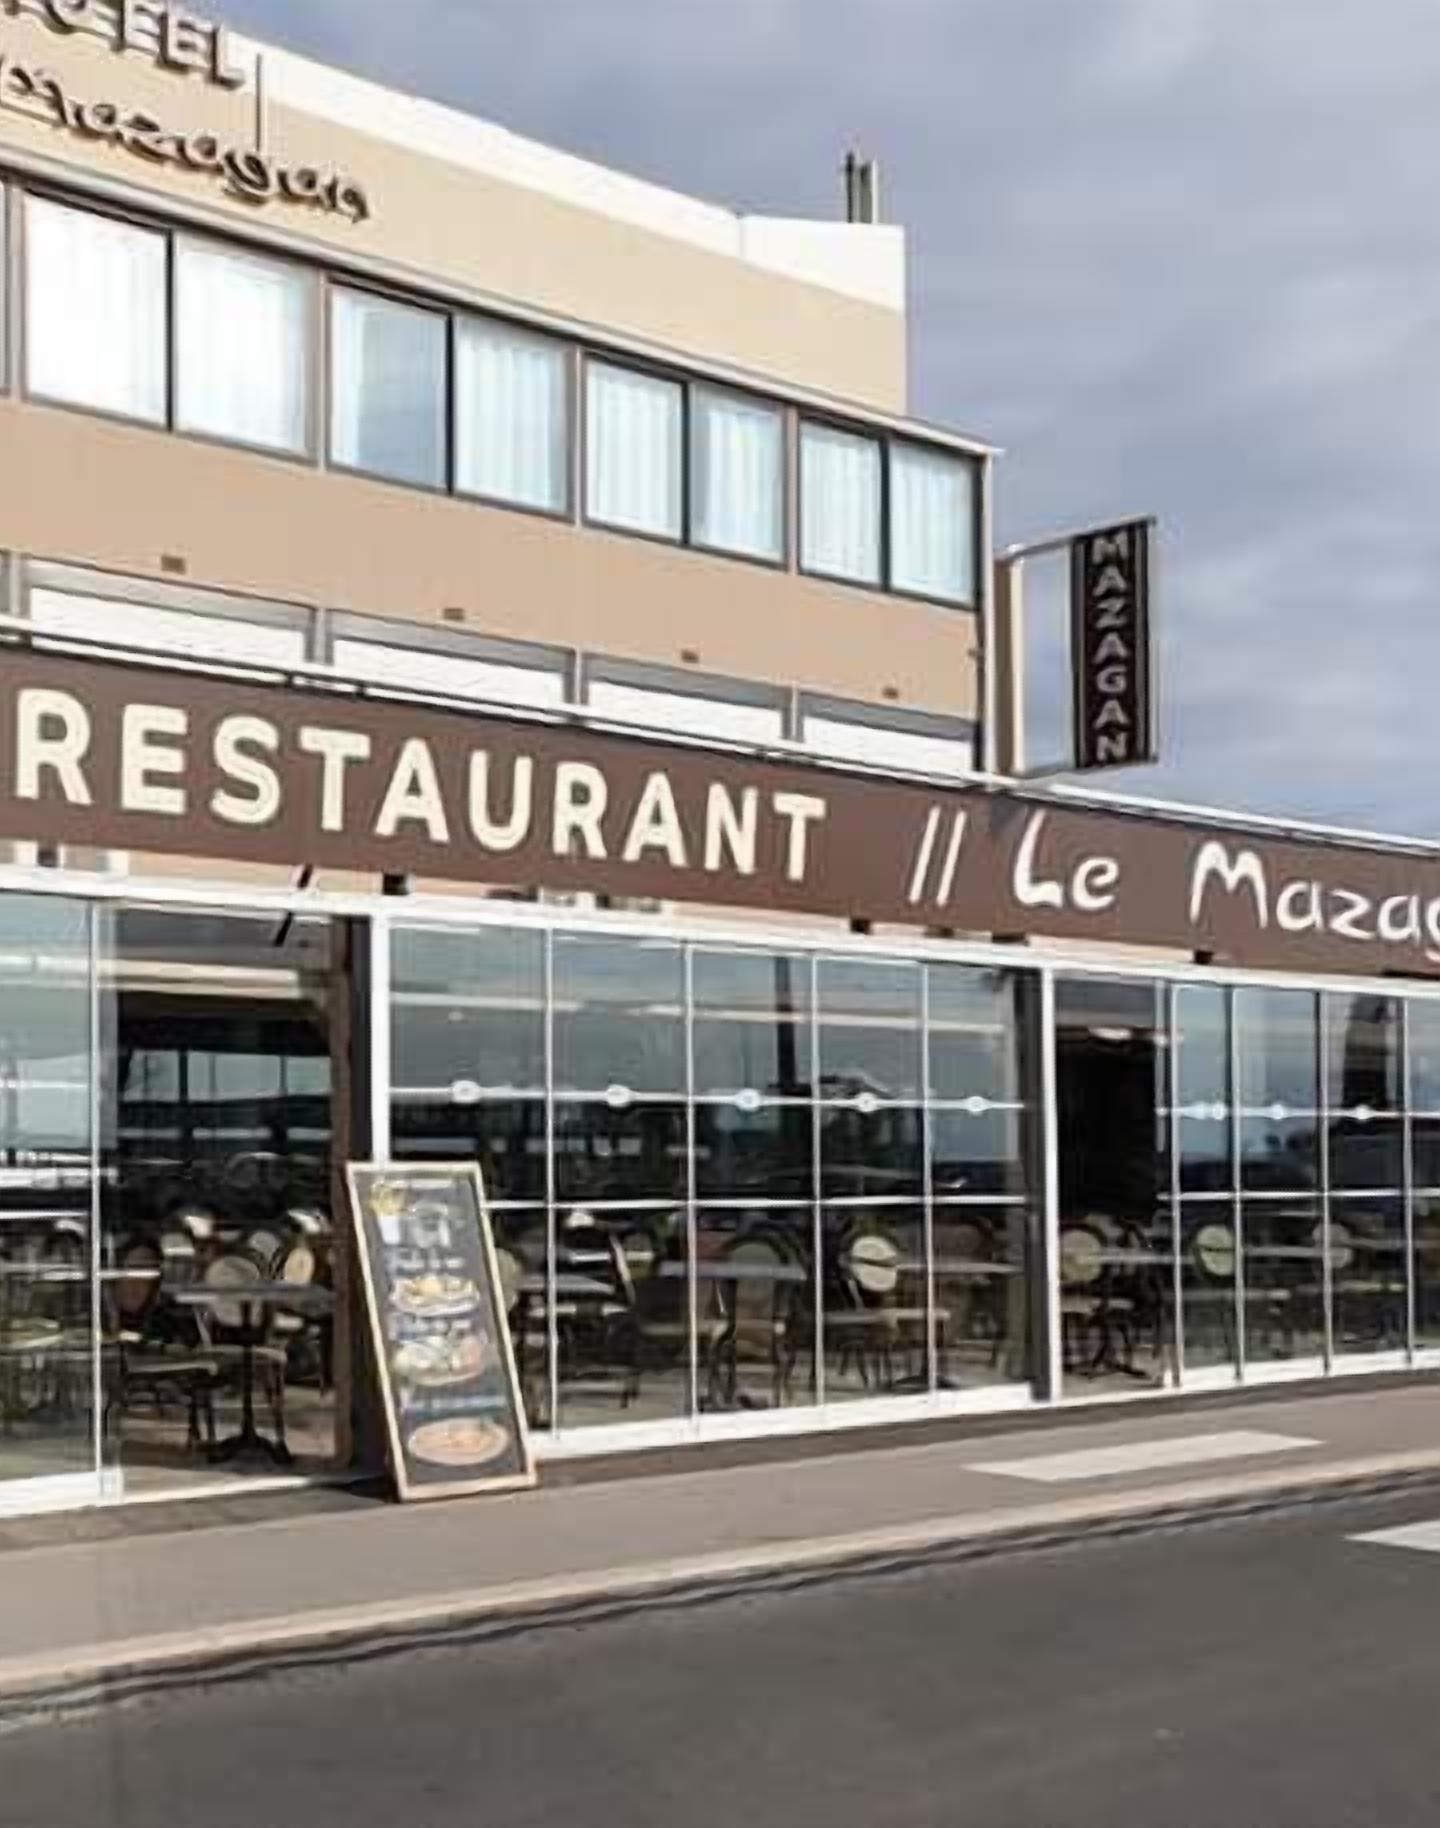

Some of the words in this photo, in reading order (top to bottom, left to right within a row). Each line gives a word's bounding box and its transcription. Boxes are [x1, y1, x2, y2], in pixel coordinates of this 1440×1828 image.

[1090, 530, 1131, 762] MAZAGAN
[14, 686, 828, 883] RESTAURANT
[1013, 810, 1120, 911] Le
